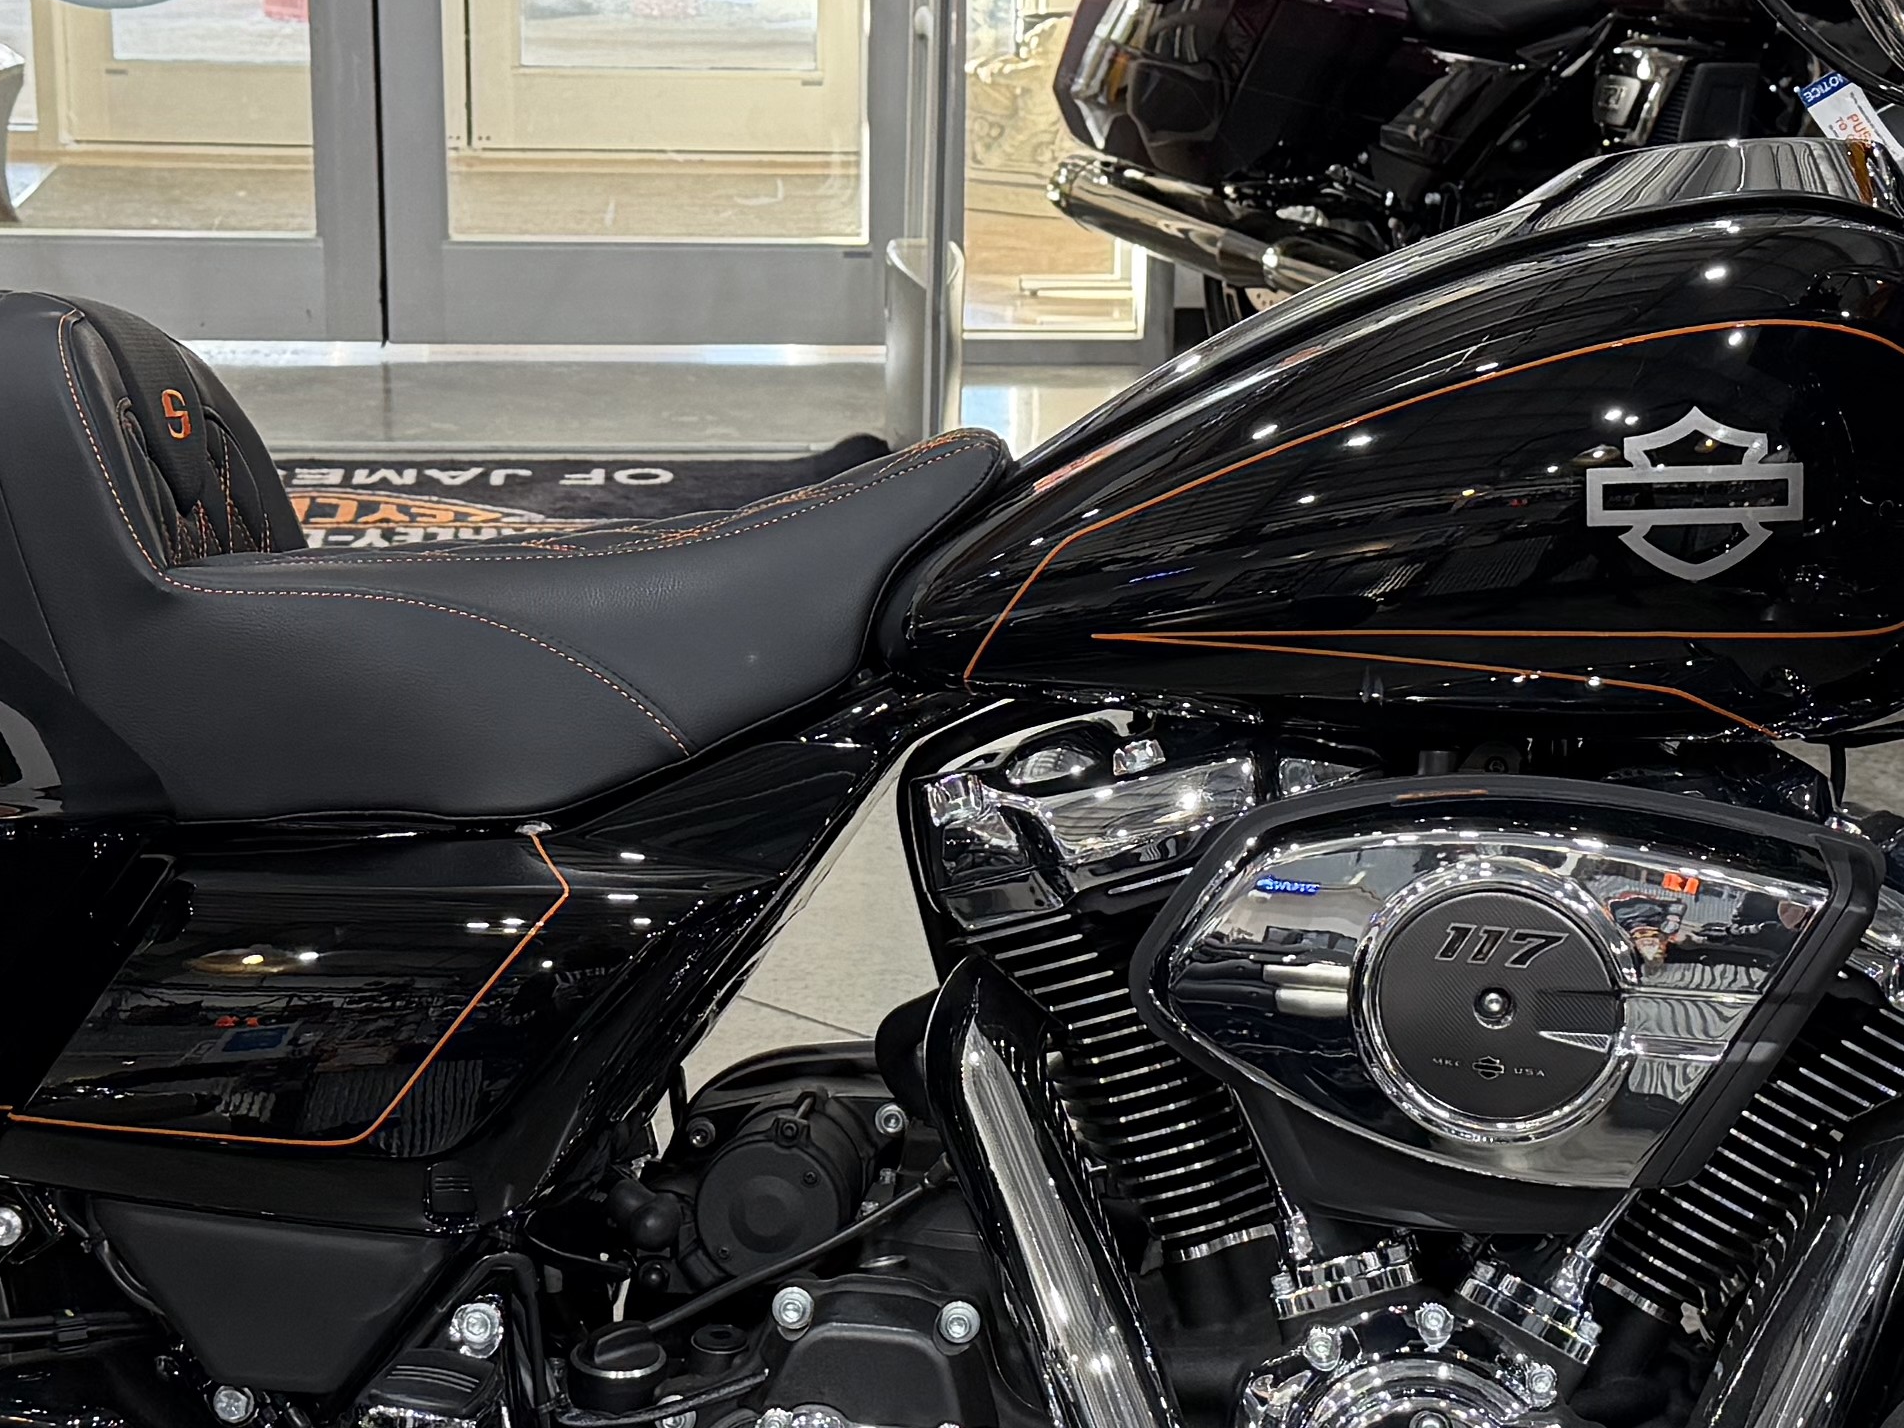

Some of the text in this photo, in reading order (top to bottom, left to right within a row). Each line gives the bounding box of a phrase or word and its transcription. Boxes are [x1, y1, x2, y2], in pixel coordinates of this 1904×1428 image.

[279, 467, 675, 486] OF JAME
[1434, 922, 1569, 969] 117
[1513, 1067, 1545, 1078] USA
